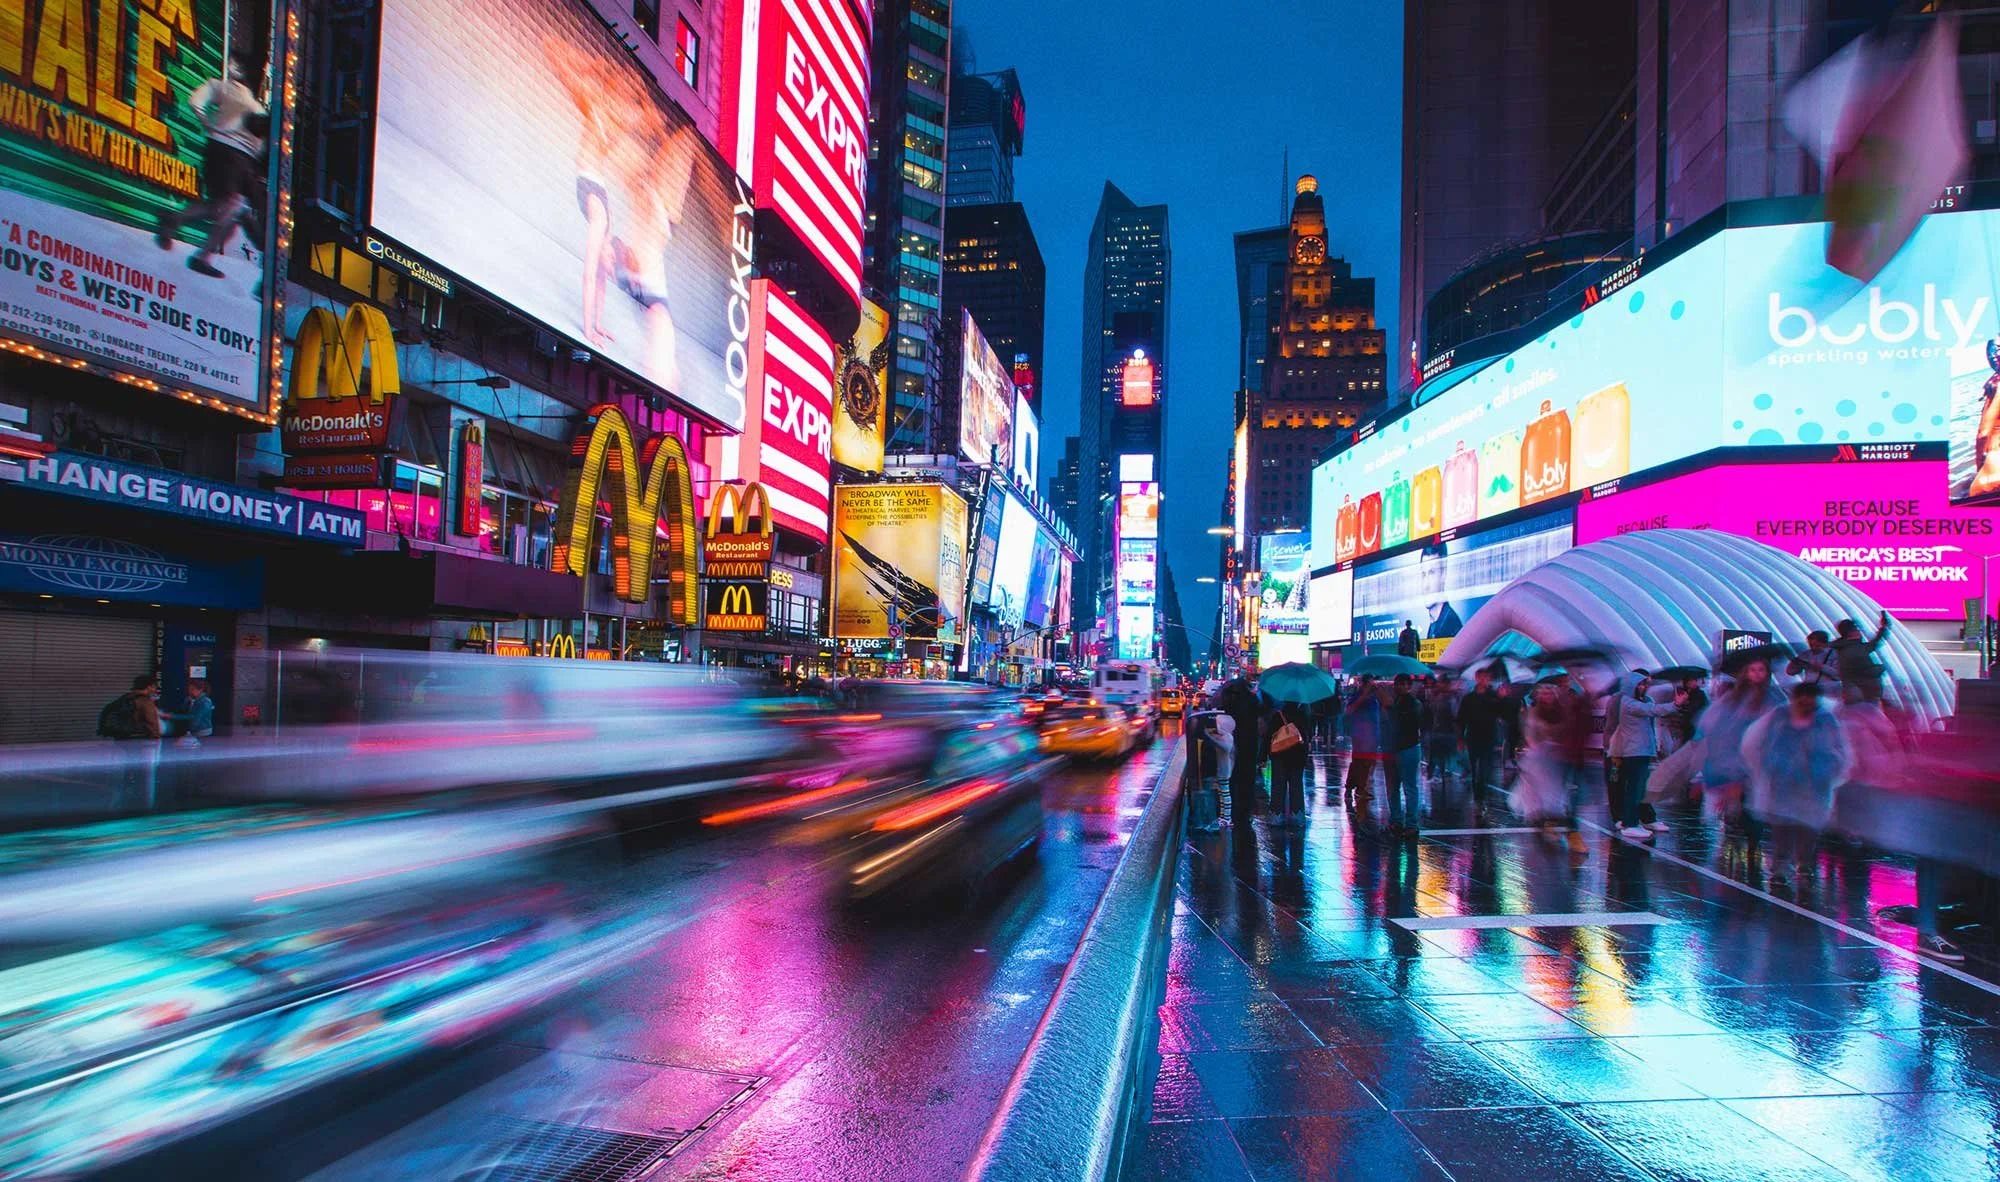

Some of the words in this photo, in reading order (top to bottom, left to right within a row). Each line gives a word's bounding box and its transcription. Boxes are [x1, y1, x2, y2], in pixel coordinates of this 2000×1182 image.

[65, 111, 107, 158] NEW
[109, 130, 137, 171] HIT
[139, 143, 200, 196] MUSICAL
[27, 229, 154, 294] COMBINATION
[157, 280, 177, 302] OF
[1601, 257, 1644, 288] MARRIOTT
[1601, 270, 1638, 297] MARQUIS
[58, 269, 77, 291] &
[82, 275, 145, 314] WEST
[148, 301, 192, 332] SIDE
[1423, 349, 1456, 372] MARRIOTT
[1767, 350, 1869, 367] sparkling
[1423, 360, 1451, 381] MARQUIS
[284, 412, 384, 432] McDonald's
[299, 432, 366, 444] Restaurant
[1861, 443, 1917, 452] MARRIOTT
[1861, 451, 1910, 460] MARQUIS
[334, 463, 374, 475] HOURS
[904, 489, 927, 498] WILL
[181, 484, 292, 526] MONEY
[308, 511, 362, 539] ATM
[841, 499, 871, 508] NEVER
[873, 499, 885, 507] BE
[886, 499, 904, 507] THE
[1823, 499, 1921, 517] BECAUSE
[1755, 519, 1878, 536] EVERYBODY
[1882, 518, 1994, 536] DESERVES
[705, 541, 770, 552] McDonald's
[1798, 547, 1896, 563] AMERICA'S
[1897, 547, 1943, 563] BEST
[0, 545, 78, 568] MONEY
[83, 556, 188, 581] EXCHANGE
[716, 552, 759, 560] Restaurant
[1873, 565, 1969, 582] NETWORK
[1366, 627, 1395, 641] EASONS
